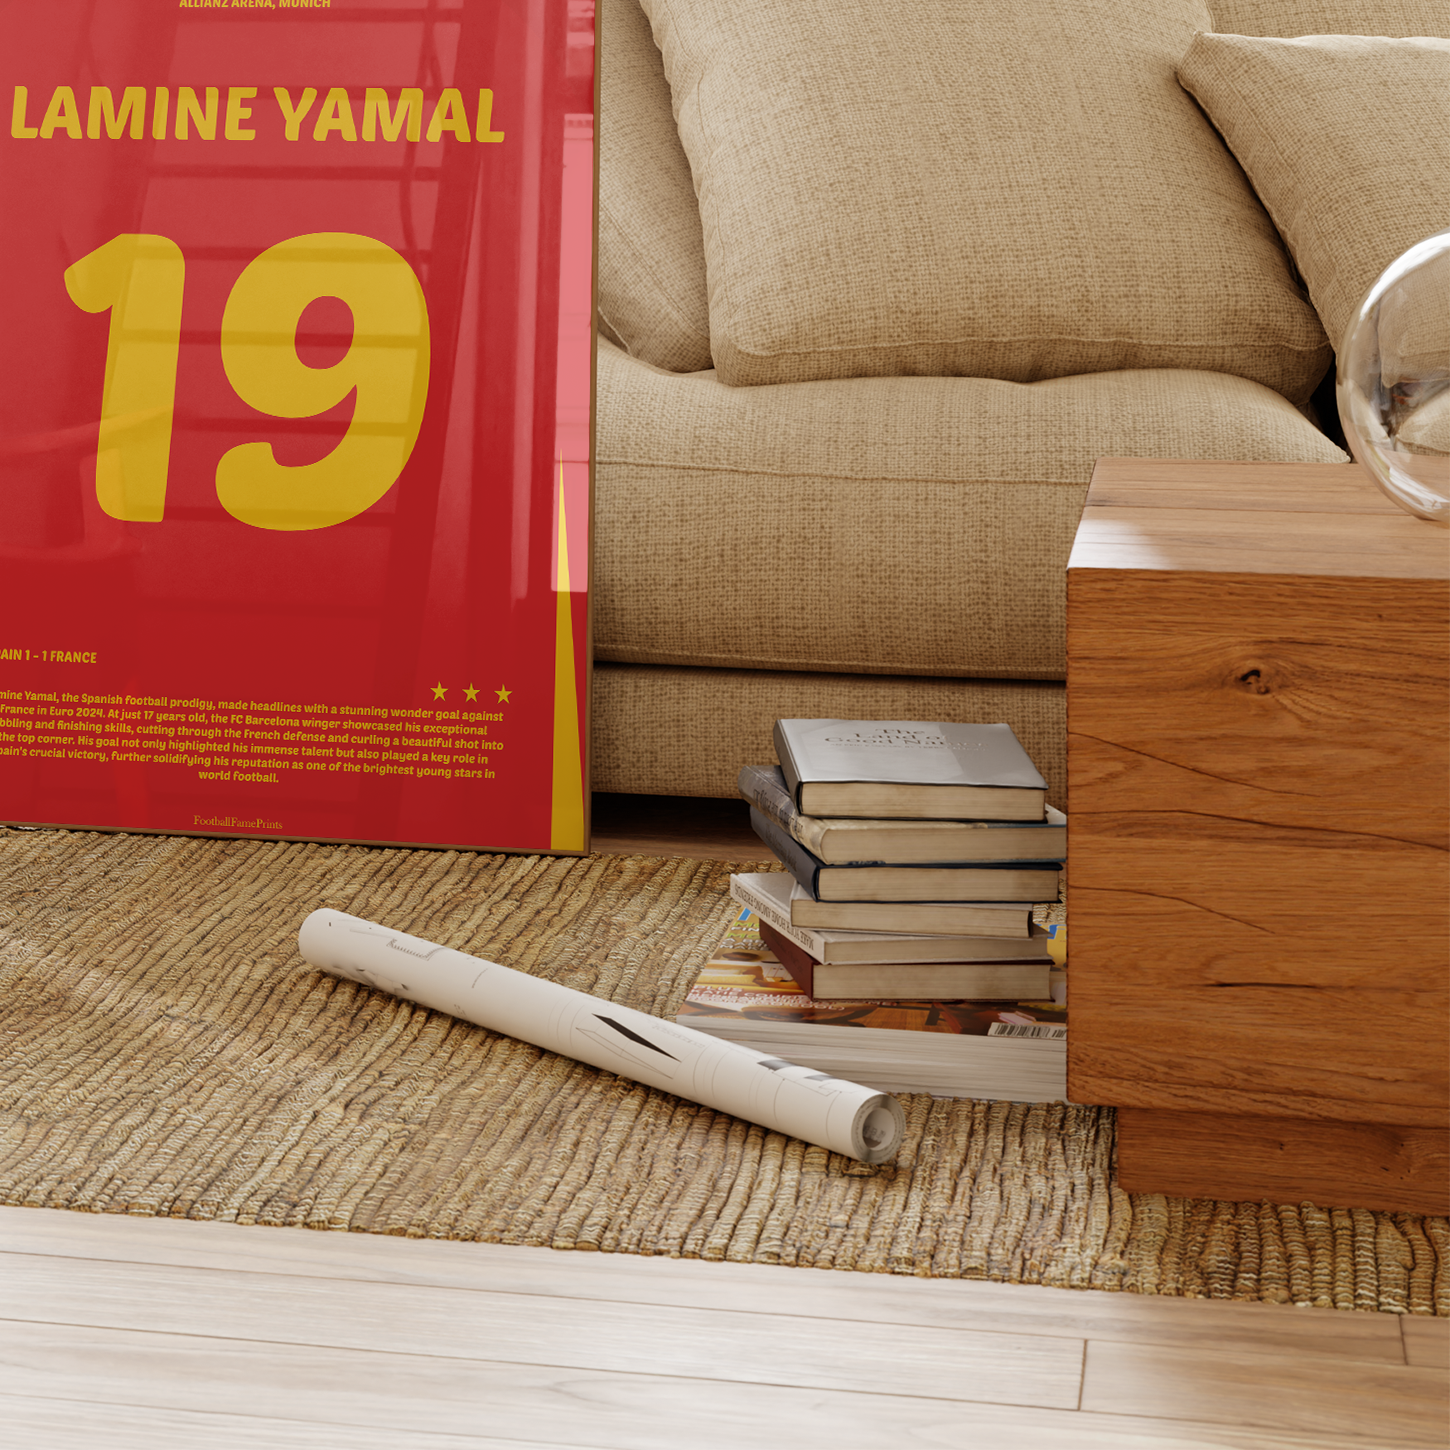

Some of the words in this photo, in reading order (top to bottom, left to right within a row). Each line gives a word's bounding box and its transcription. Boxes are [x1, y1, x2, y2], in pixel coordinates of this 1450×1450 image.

[11, 86, 258, 141] LAMINE
[273, 87, 505, 143] YAMAL
[64, 232, 431, 531] 19
[25, 649, 30, 661] 1
[42, 650, 47, 661] 1
[50, 650, 97, 664] FRANCE
[24, 690, 59, 704] Yamal,
[61, 692, 80, 703] the
[81, 693, 123, 705] Spanish
[125, 695, 168, 707] football
[169, 698, 216, 711] prodigy,
[218, 700, 249, 710] made
[250, 700, 302, 713] headlines
[303, 703, 328, 714] with
[330, 706, 338, 714] a
[339, 705, 388, 719] stunning
[390, 708, 434, 718] wonder
[435, 709, 460, 721] goal
[462, 711, 504, 723] against
[0, 704, 35, 715] France
[37, 705, 47, 715] in
[49, 706, 74, 717] Euro
[76, 707, 106, 718] 2024.
[107, 709, 119, 719] At
[119, 710, 142, 721] just
[143, 710, 154, 720] 17
[156, 713, 186, 723] years
[188, 712, 208, 725] old,
[210, 713, 228, 724] the
[230, 714, 244, 724] FC
[245, 715, 300, 727] Barcelona
[301, 717, 341, 730] winger
[342, 719, 403, 732] showcased
[405, 722, 421, 733] his
[423, 724, 488, 736] exceptional
[34, 720, 55, 729] and
[56, 720, 103, 734] finishing
[104, 722, 134, 735] skills,
[136, 724, 175, 738] cutting
[177, 726, 222, 739] through
[224, 728, 242, 738] the
[244, 729, 281, 740] French
[283, 730, 326, 742] defense
[327, 733, 349, 743] and
[350, 734, 390, 748] curling
[392, 737, 400, 746] a
[401, 736, 452, 748] beautiful
[454, 738, 479, 749] shot
[481, 739, 504, 750] into
[17, 733, 36, 745] top
[37, 735, 75, 745] corner.
[77, 735, 94, 746] His
[95, 737, 119, 748] goal
[121, 738, 140, 748] not
[142, 739, 166, 751] only
[168, 739, 230, 753] highlighted
[232, 742, 248, 753] his
[250, 743, 299, 755] immense
[301, 746, 334, 757] talent
[336, 747, 355, 758] but
[356, 748, 380, 759] also
[381, 750, 420, 762] played
[421, 753, 429, 762] a
[430, 751, 450, 765] key
[452, 753, 476, 764] role
[477, 753, 488, 764] in
[29, 748, 66, 758] crucial
[67, 749, 109, 763] victory,
[111, 750, 152, 762] further
[153, 753, 211, 768] solidifying
[213, 755, 229, 766] his
[231, 758, 289, 769] reputation
[291, 761, 304, 770] as
[306, 762, 327, 771] one
[328, 761, 342, 771] of
[343, 762, 361, 772] the
[363, 763, 415, 776] brightest
[416, 767, 452, 779] young
[454, 768, 483, 778] stars
[484, 768, 495, 779] in
[198, 770, 231, 780] world
[233, 770, 279, 783] football.
[193, 815, 283, 829] FootballFamePrints
[734, 883, 754, 908] FRIENDS
[754, 898, 771, 918] AMONG
[771, 910, 786, 931] HOME
[786, 921, 800, 941] YOUR
[800, 931, 814, 950] MAKE
